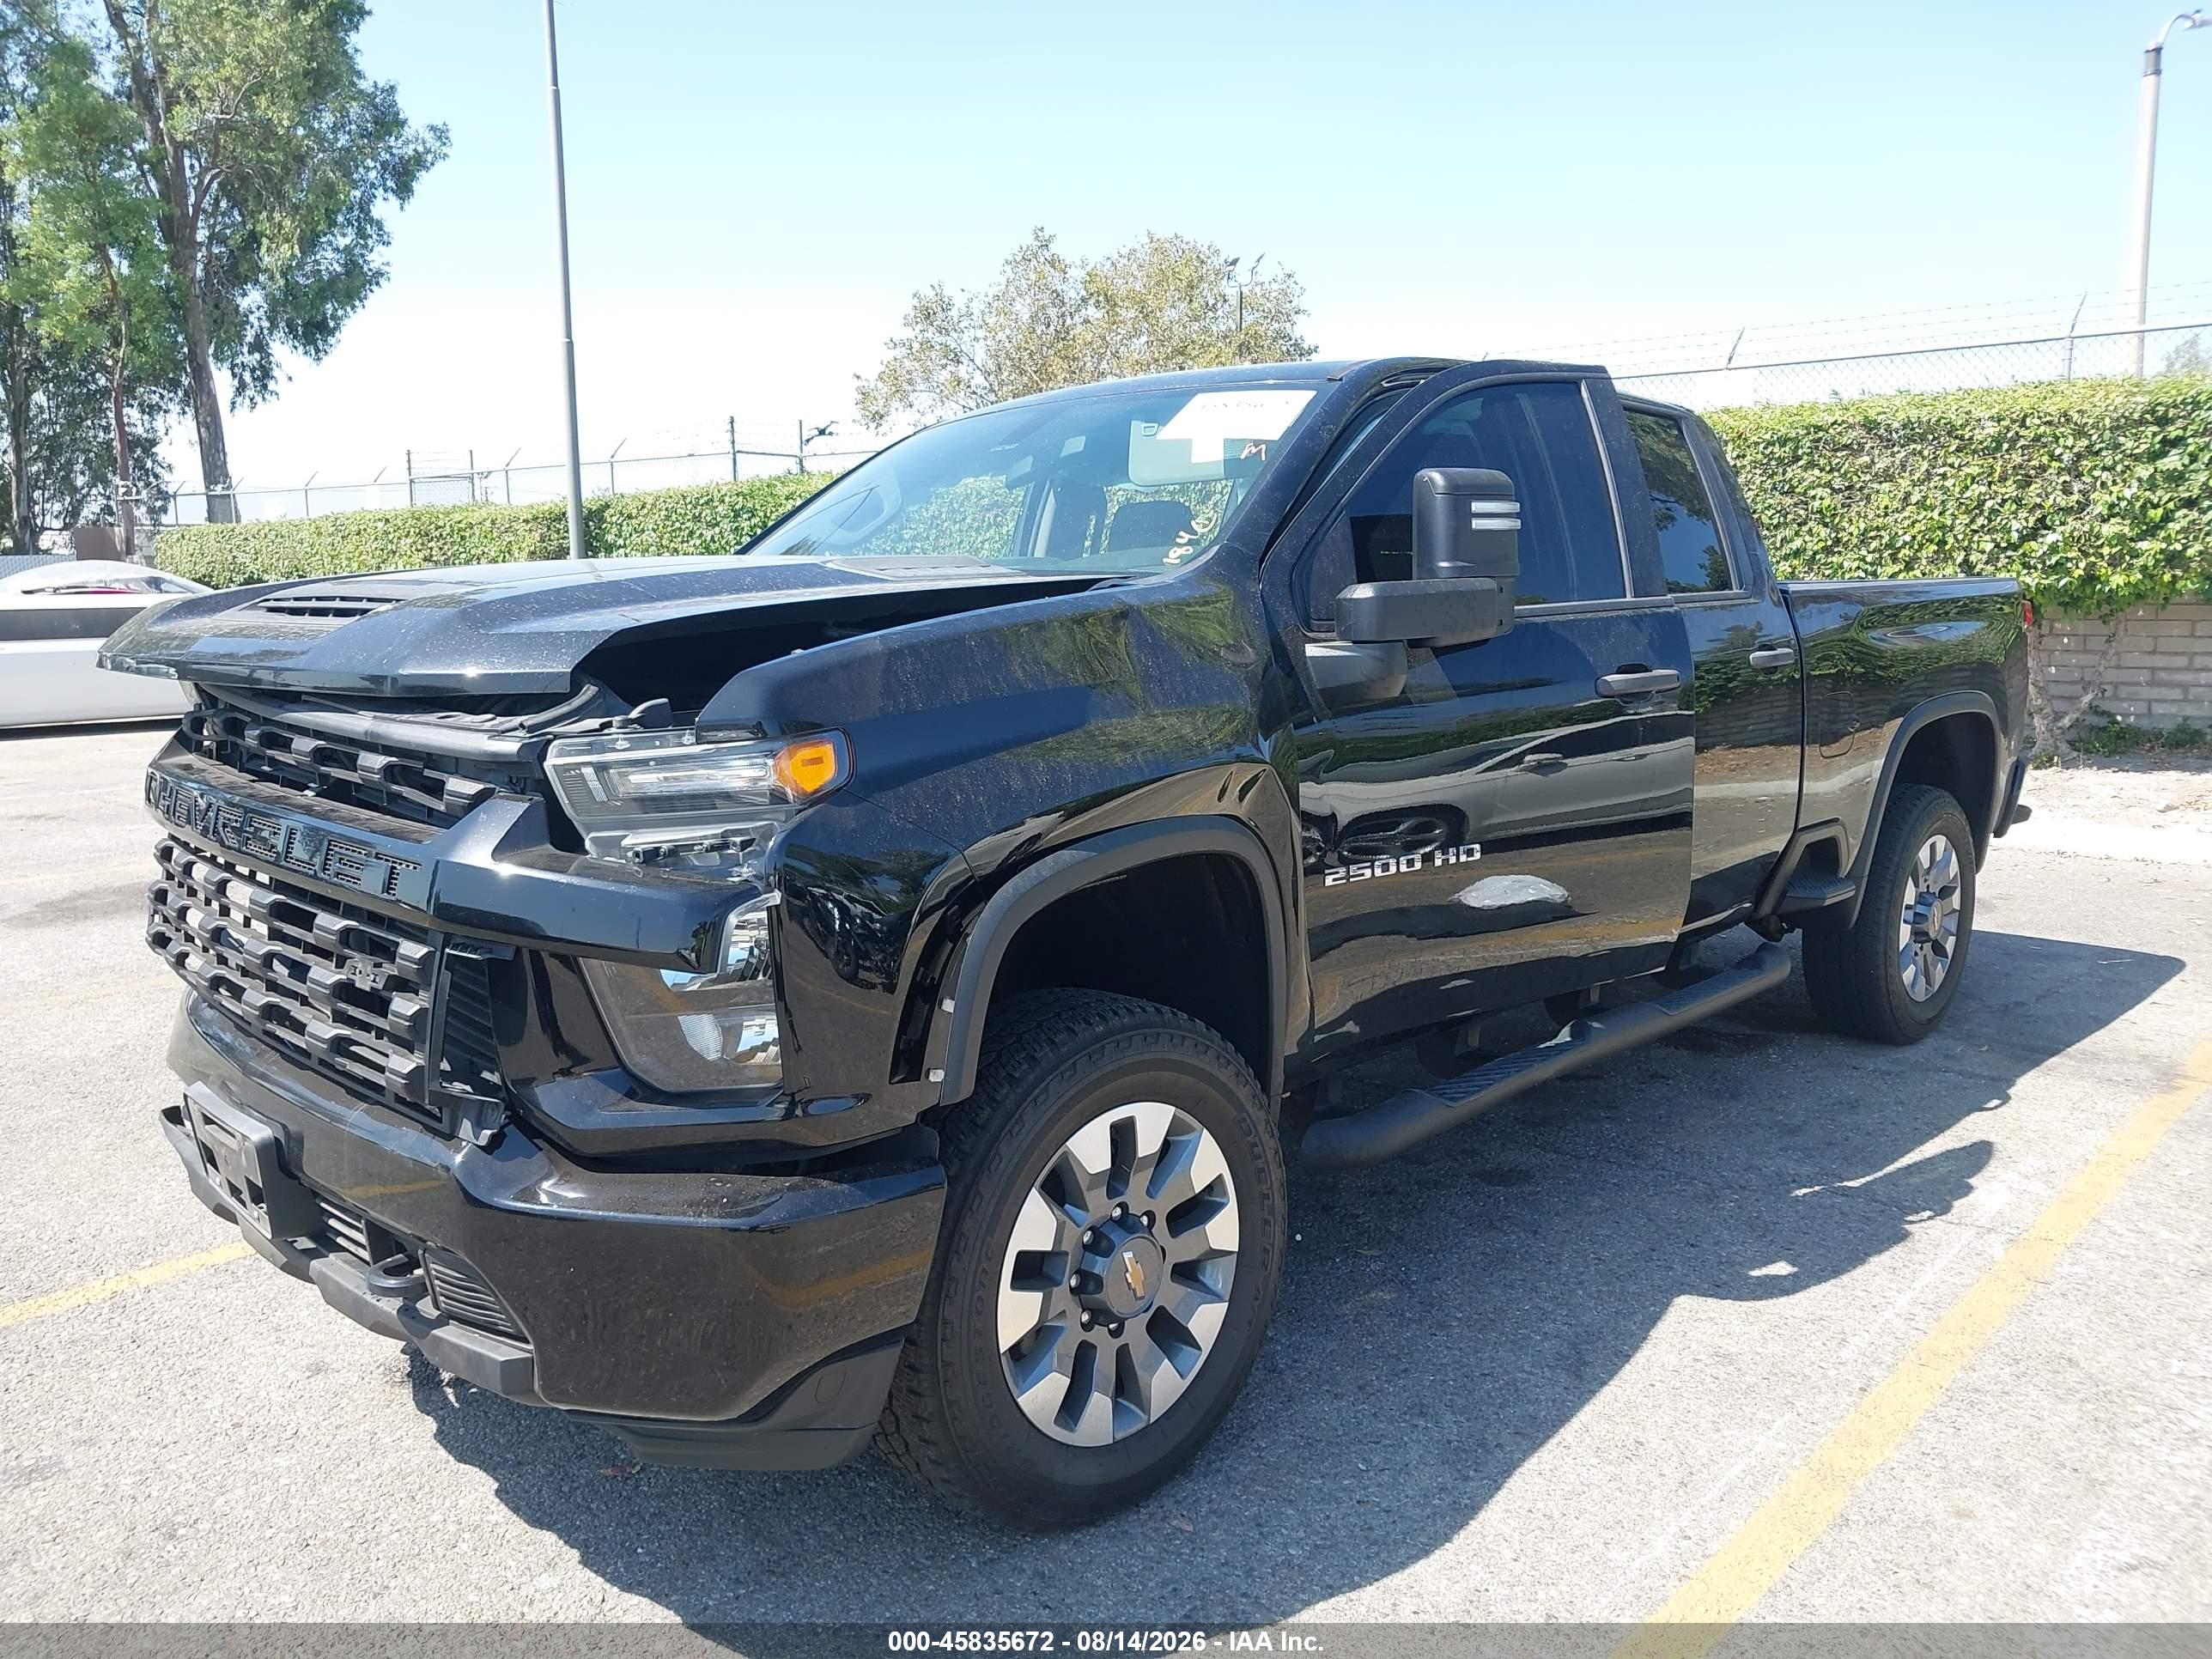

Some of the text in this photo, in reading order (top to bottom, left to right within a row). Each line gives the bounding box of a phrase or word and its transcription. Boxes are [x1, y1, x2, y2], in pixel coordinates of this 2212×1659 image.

[145, 770, 423, 899] CHEVROLET
[1324, 843, 1482, 887] 2500 HD
[1232, 1109, 1272, 1273] DUELER
